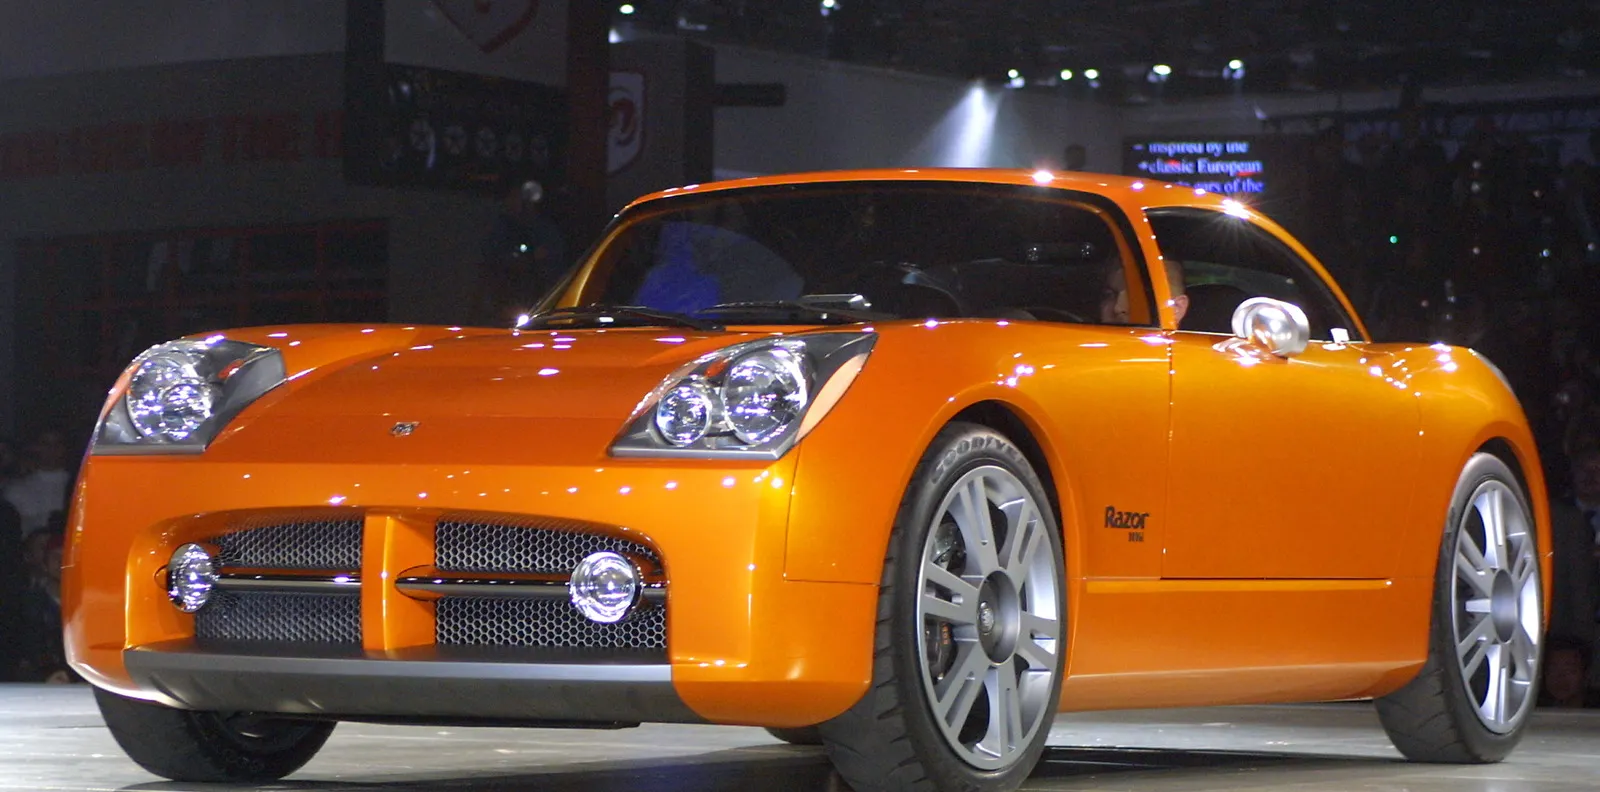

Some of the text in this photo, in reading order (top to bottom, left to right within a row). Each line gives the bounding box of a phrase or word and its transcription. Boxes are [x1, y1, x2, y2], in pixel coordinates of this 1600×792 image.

[1148, 157, 1263, 176] classic European
[1223, 178, 1240, 193] of
[1241, 178, 1264, 193] the
[1104, 505, 1150, 530] Razor
